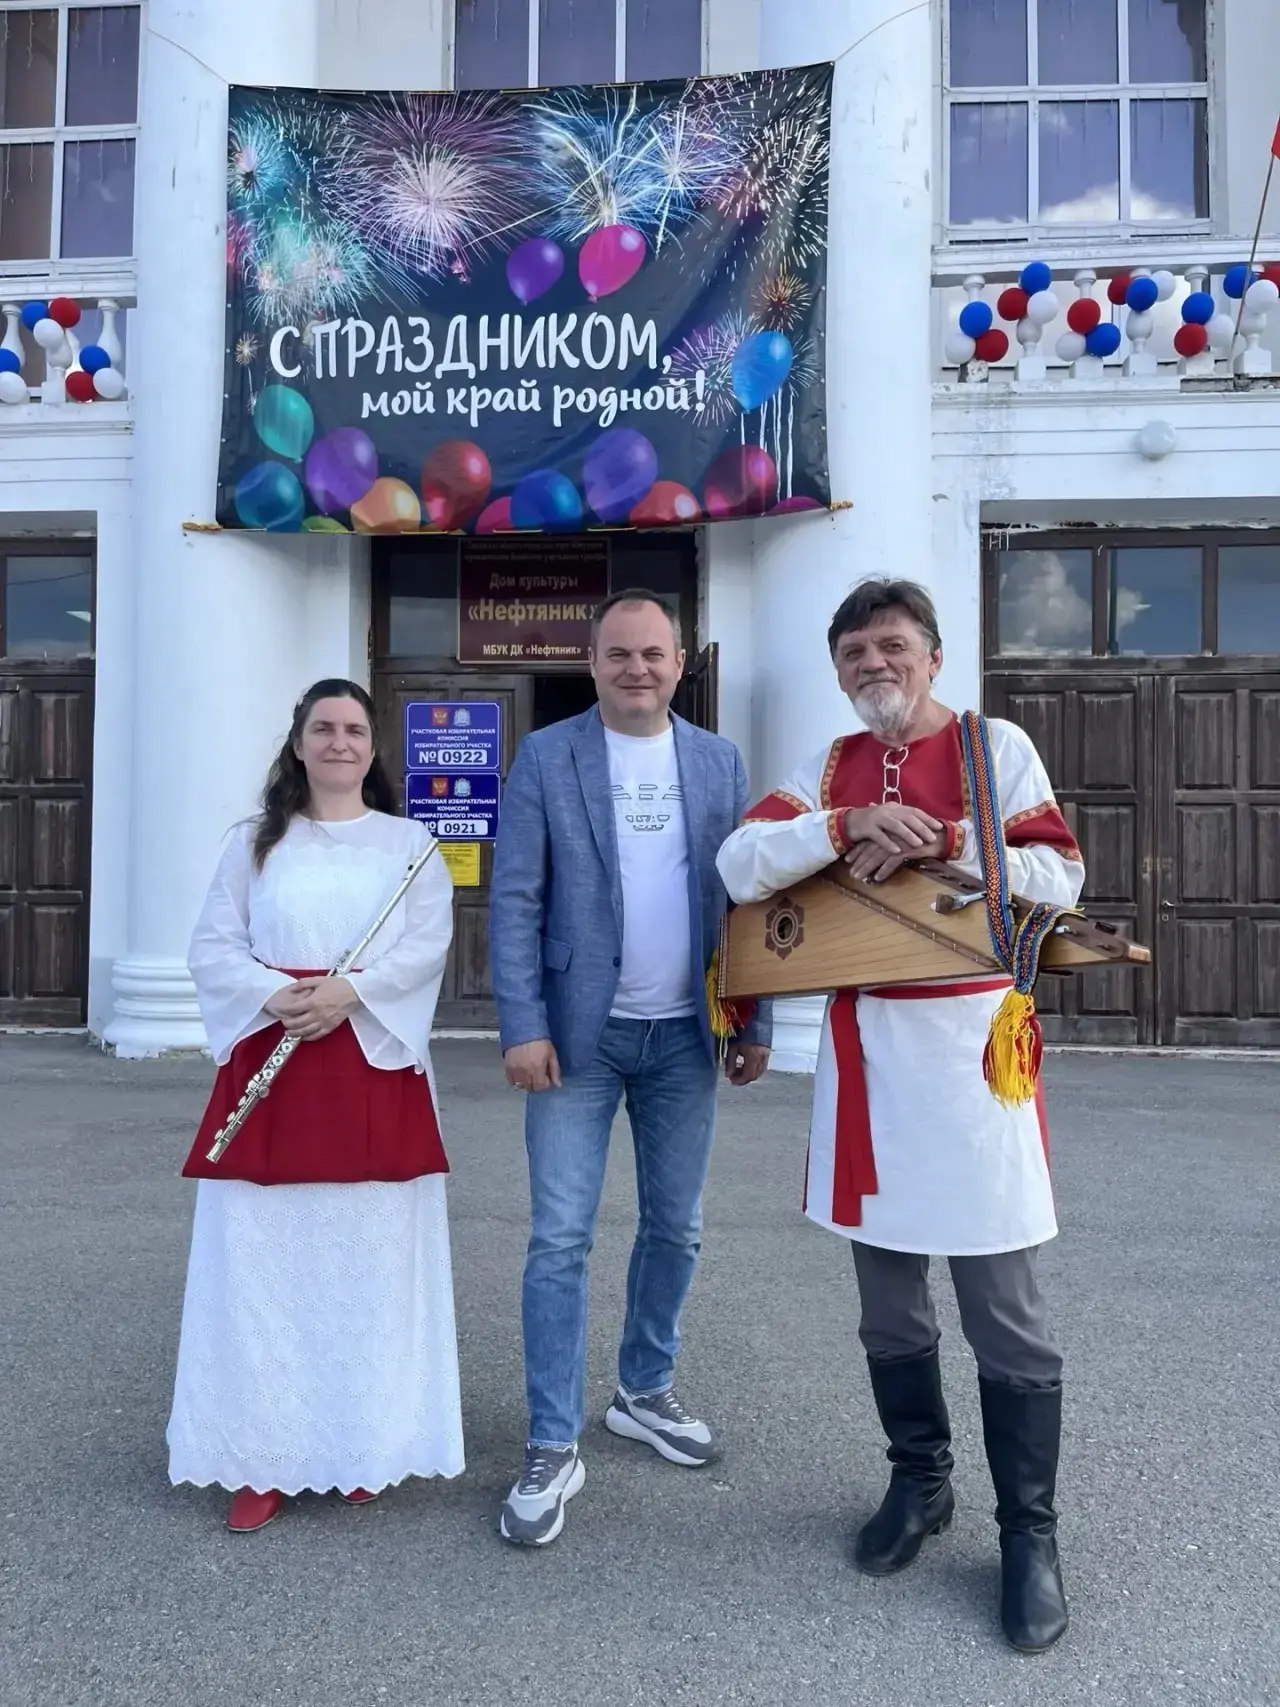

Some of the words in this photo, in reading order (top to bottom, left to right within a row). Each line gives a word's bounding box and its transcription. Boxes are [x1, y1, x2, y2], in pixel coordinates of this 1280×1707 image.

[269, 325, 301, 378] С
[312, 311, 674, 379] ПРАЗДНИКОМ,
[360, 380, 435, 419] мой
[446, 379, 541, 428] край
[552, 368, 707, 429] родной!
[489, 573, 515, 589] Дом
[519, 574, 578, 591] культуры
[483, 644, 508, 656] МБУК
[510, 644, 523, 657] ДК
[525, 644, 581, 657] «Нефтяник»
[442, 751, 483, 763] 0922
[444, 823, 477, 834] 0921
